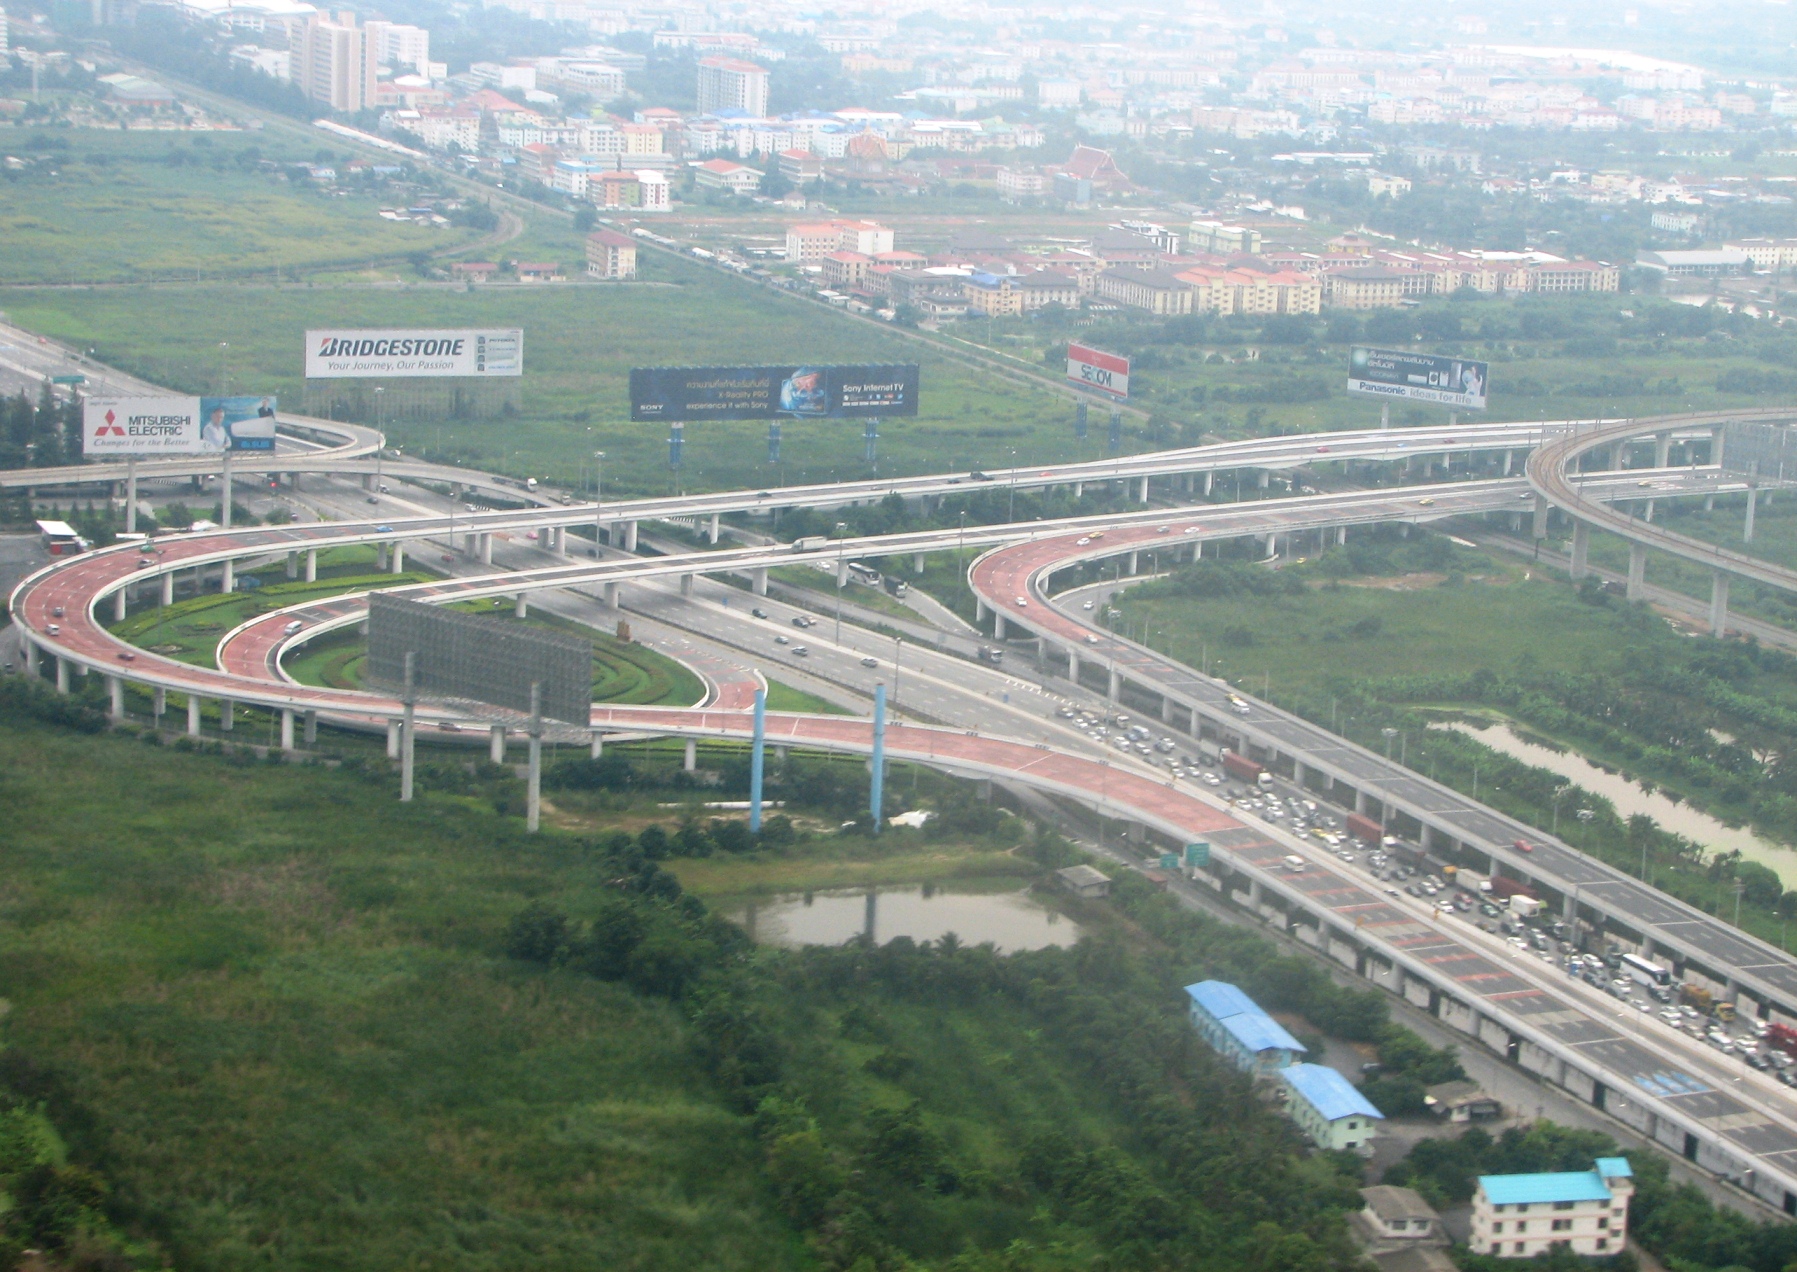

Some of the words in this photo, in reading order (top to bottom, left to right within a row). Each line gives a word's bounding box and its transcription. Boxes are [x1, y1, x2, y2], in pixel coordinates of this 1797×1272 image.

[319, 338, 465, 356] BRIDGESTONE
[328, 361, 349, 370] Your
[352, 361, 394, 371] Journey,
[397, 360, 415, 369] Our
[418, 360, 454, 369] Passion
[842, 384, 862, 393] Sony
[863, 384, 893, 392] Internet
[894, 383, 904, 391] TV
[1359, 382, 1406, 395] Panasonic
[1410, 388, 1437, 400] ideas
[1440, 392, 1453, 402] for
[1455, 394, 1472, 405] life
[686, 402, 727, 410] experience
[751, 401, 769, 410] Sony
[129, 416, 191, 426] MITSUBISHI
[129, 426, 183, 436] ELECTRIC
[93, 438, 130, 448] Changes
[132, 438, 145, 448] for
[148, 438, 161, 446] the
[164, 438, 190, 446] Better
